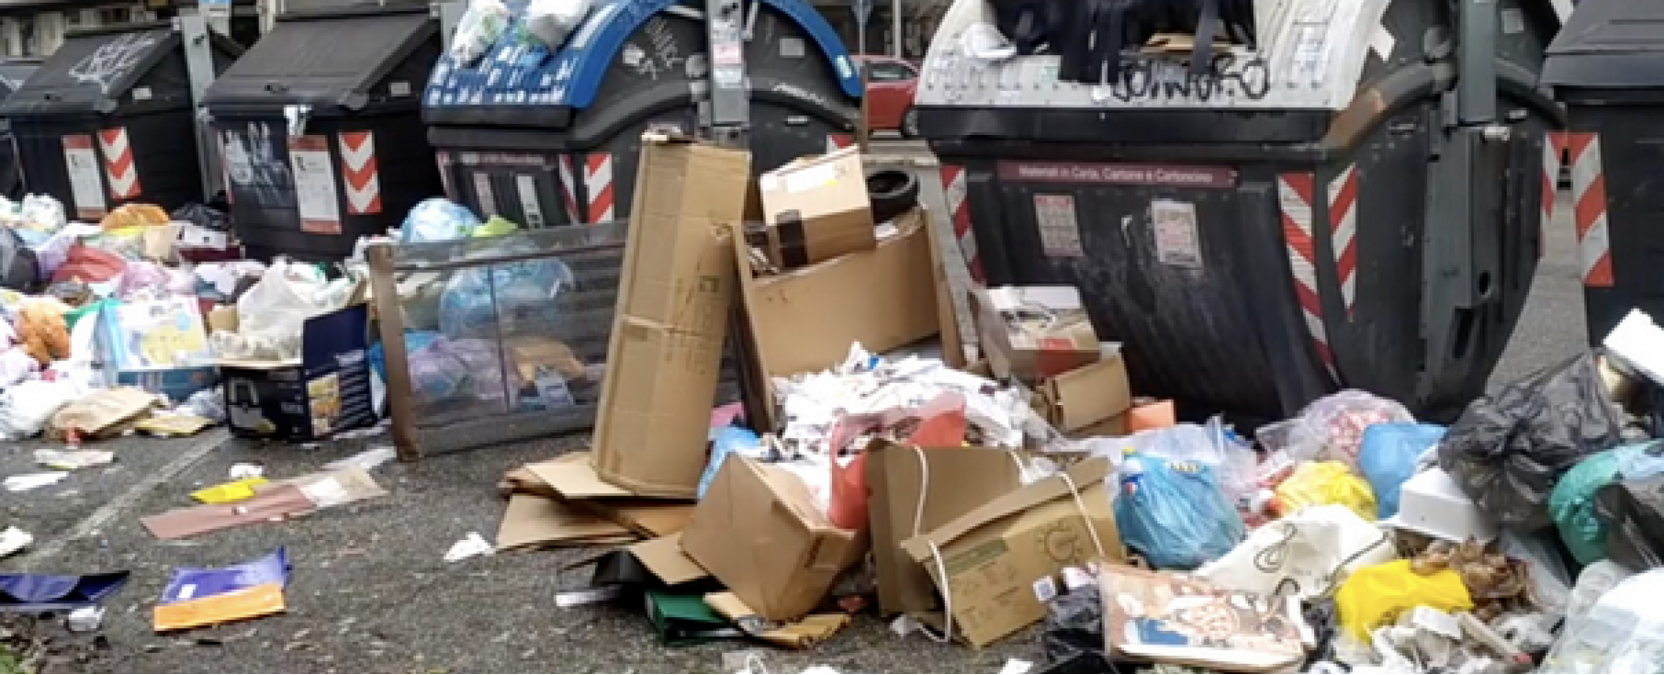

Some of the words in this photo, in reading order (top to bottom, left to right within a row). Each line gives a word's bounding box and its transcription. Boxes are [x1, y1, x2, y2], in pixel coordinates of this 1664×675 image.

[1018, 165, 1058, 177] Materiali
[1060, 167, 1070, 177] in
[1101, 167, 1144, 180] Cartone
[1146, 170, 1153, 180] e
[1156, 168, 1213, 182] Cartoncino
